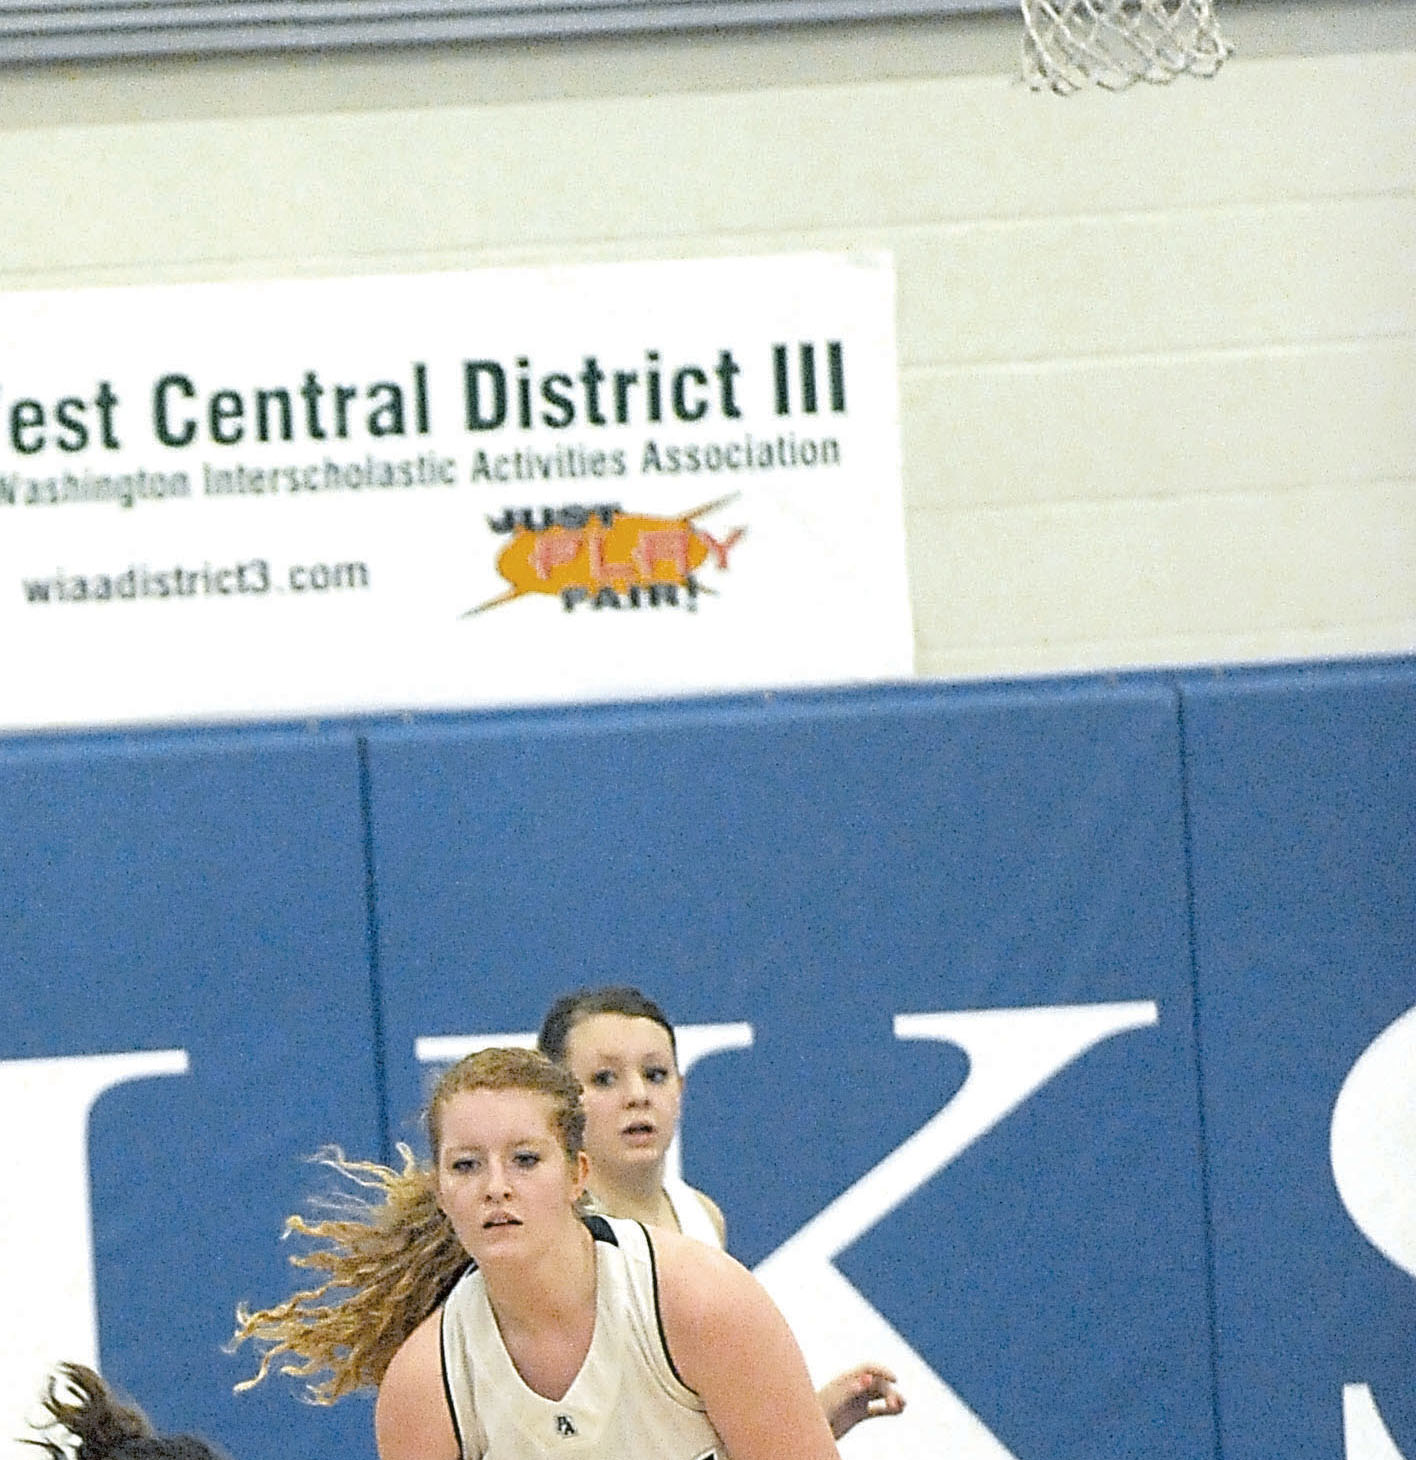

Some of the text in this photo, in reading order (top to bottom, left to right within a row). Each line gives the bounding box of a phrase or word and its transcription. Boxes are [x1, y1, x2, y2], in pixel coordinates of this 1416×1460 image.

[152, 361, 429, 448] Central
[464, 349, 742, 432] District
[771, 340, 846, 416] III
[201, 451, 456, 496] Interscholastic
[471, 442, 627, 483] Activities
[640, 432, 842, 474] Association
[486, 500, 622, 534] JUST
[22, 558, 369, 605] wiaadistrict3.com
[529, 524, 748, 582] PLAY
